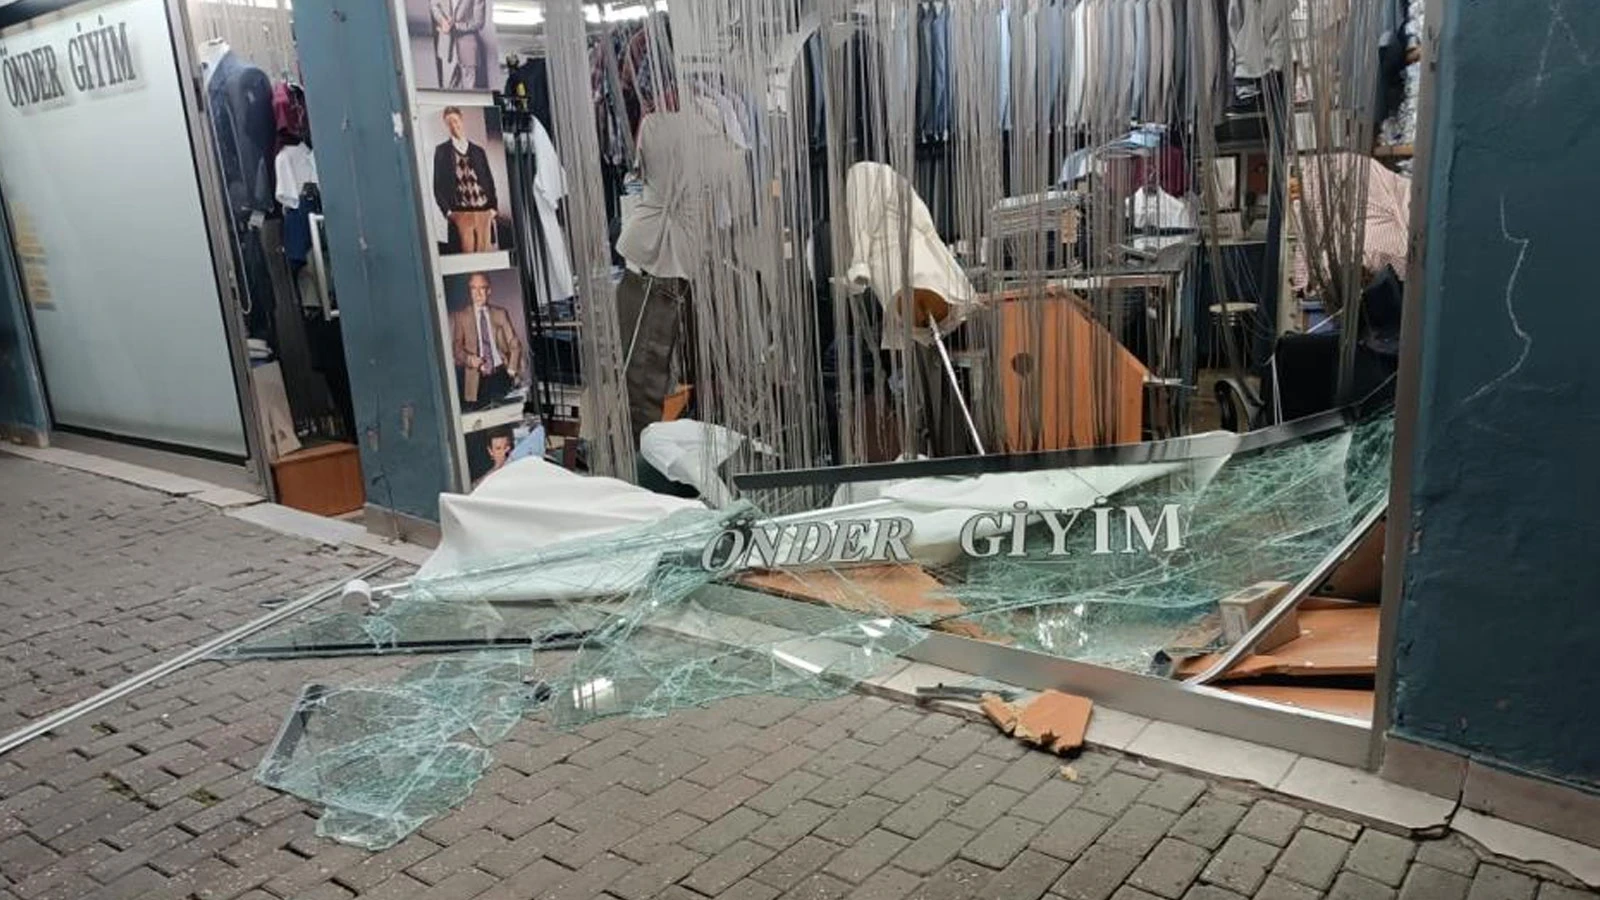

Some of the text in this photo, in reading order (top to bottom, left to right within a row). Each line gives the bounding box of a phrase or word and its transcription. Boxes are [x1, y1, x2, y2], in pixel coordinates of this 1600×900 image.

[0, 14, 136, 107] ÖNDER GİYİM
[700, 496, 1185, 572] ÖNDER GİYİM
